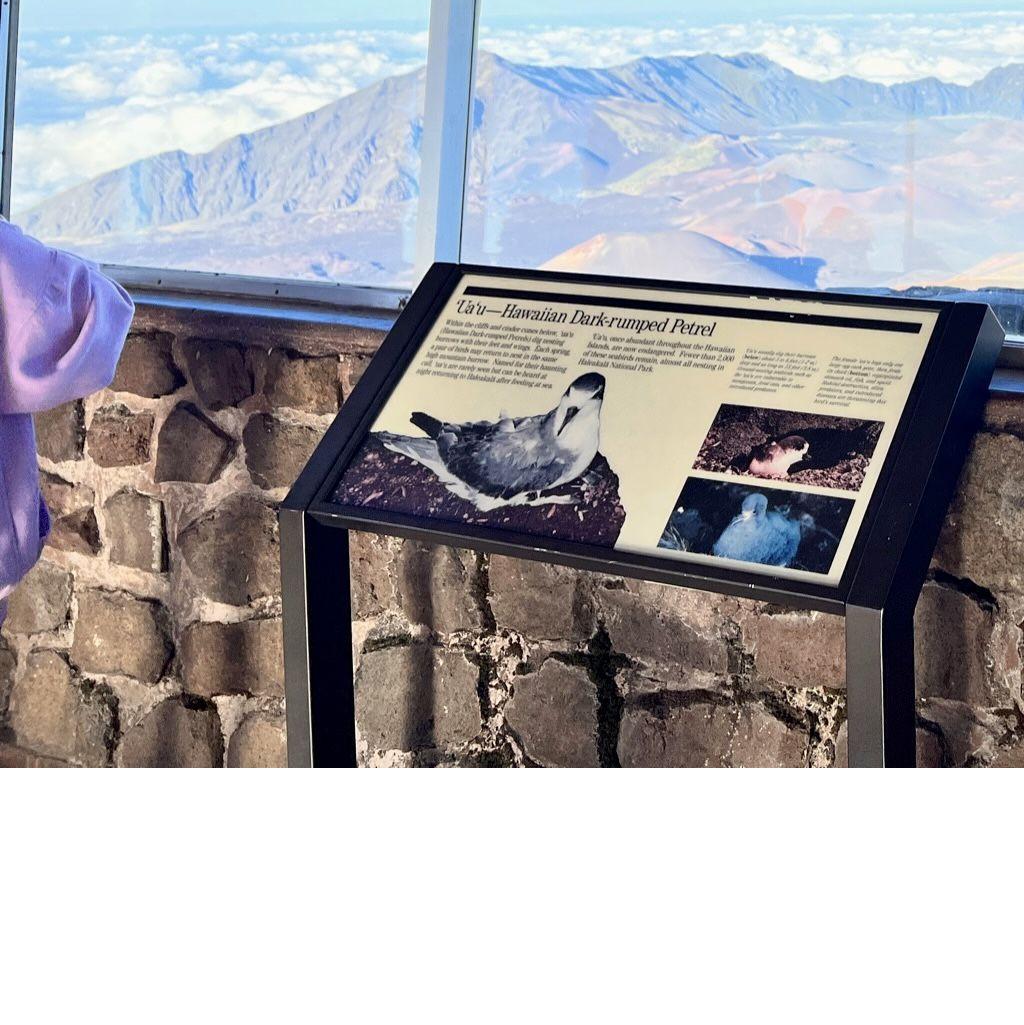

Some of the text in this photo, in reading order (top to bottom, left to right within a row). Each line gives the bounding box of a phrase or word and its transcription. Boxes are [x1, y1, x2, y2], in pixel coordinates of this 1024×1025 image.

[569, 309, 669, 334] Dark-rumped
[669, 318, 717, 337] Petrel
[436, 335, 459, 343] burrows
[535, 345, 550, 353] Each
[440, 327, 469, 335] (Hawaiian
[470, 330, 508, 339] Dark-rumped
[543, 339, 565, 347] nesting
[625, 337, 656, 346] abundant
[656, 340, 692, 350] throughout
[704, 344, 736, 353] Hawaiian
[608, 353, 634, 362] seabirds
[659, 358, 682, 366] almost
[679, 350, 701, 359] Fewer
[493, 358, 515, 366] Named
[540, 364, 567, 373] haunting
[609, 362, 637, 371] National
[431, 370, 459, 379] returning
[511, 378, 534, 388] feeding
